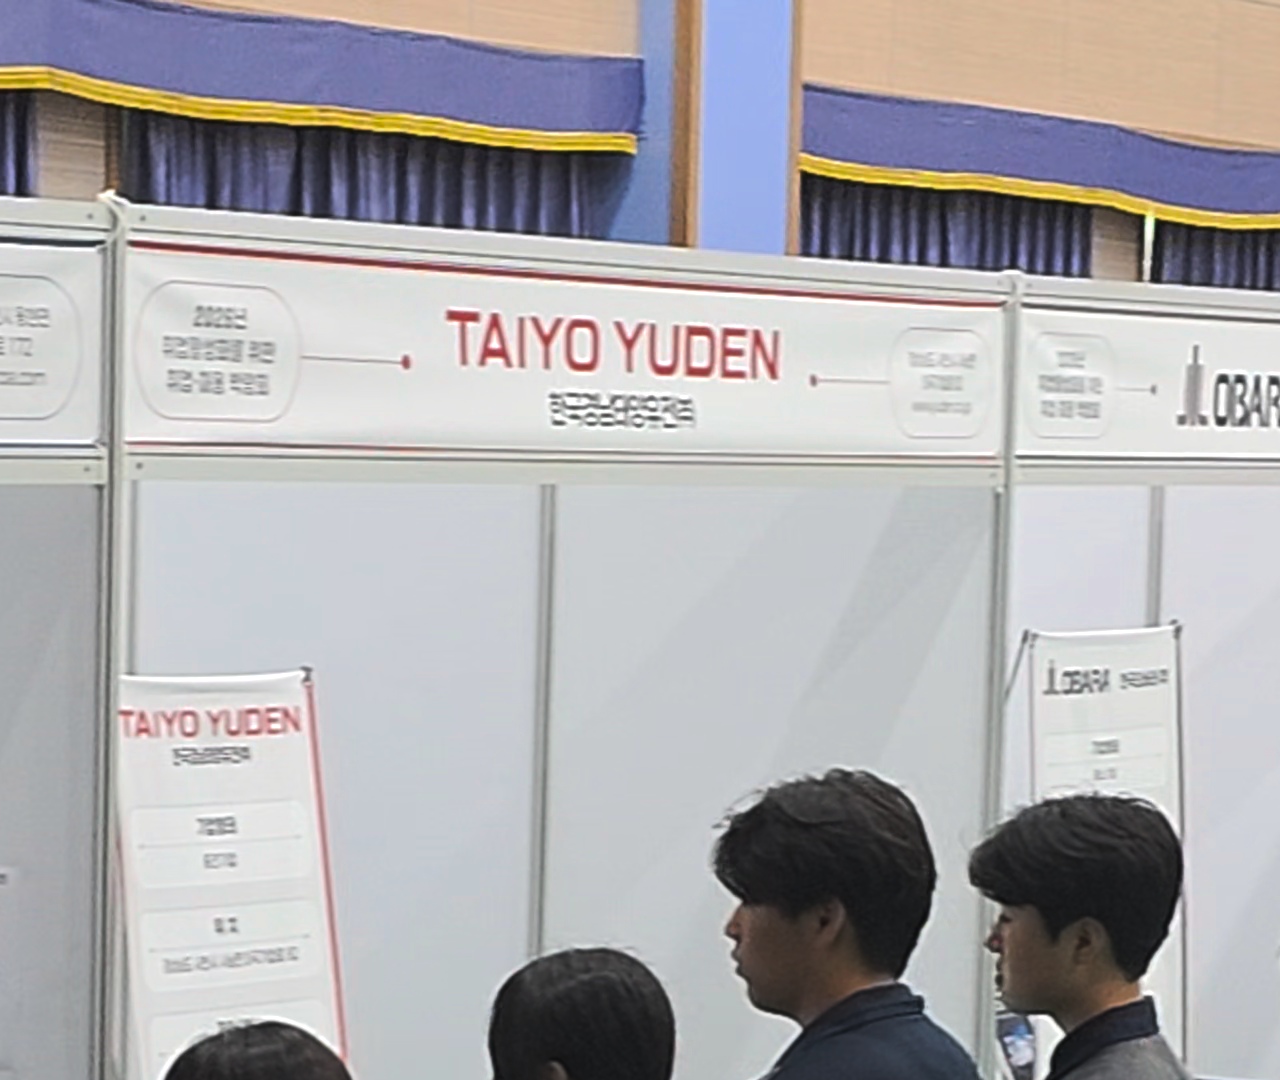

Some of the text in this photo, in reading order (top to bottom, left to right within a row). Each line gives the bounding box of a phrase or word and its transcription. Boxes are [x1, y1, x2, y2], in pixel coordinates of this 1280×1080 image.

[445, 308, 781, 382] TAIYO YUDEN
[117, 705, 302, 739] TAIYO YUDEN
